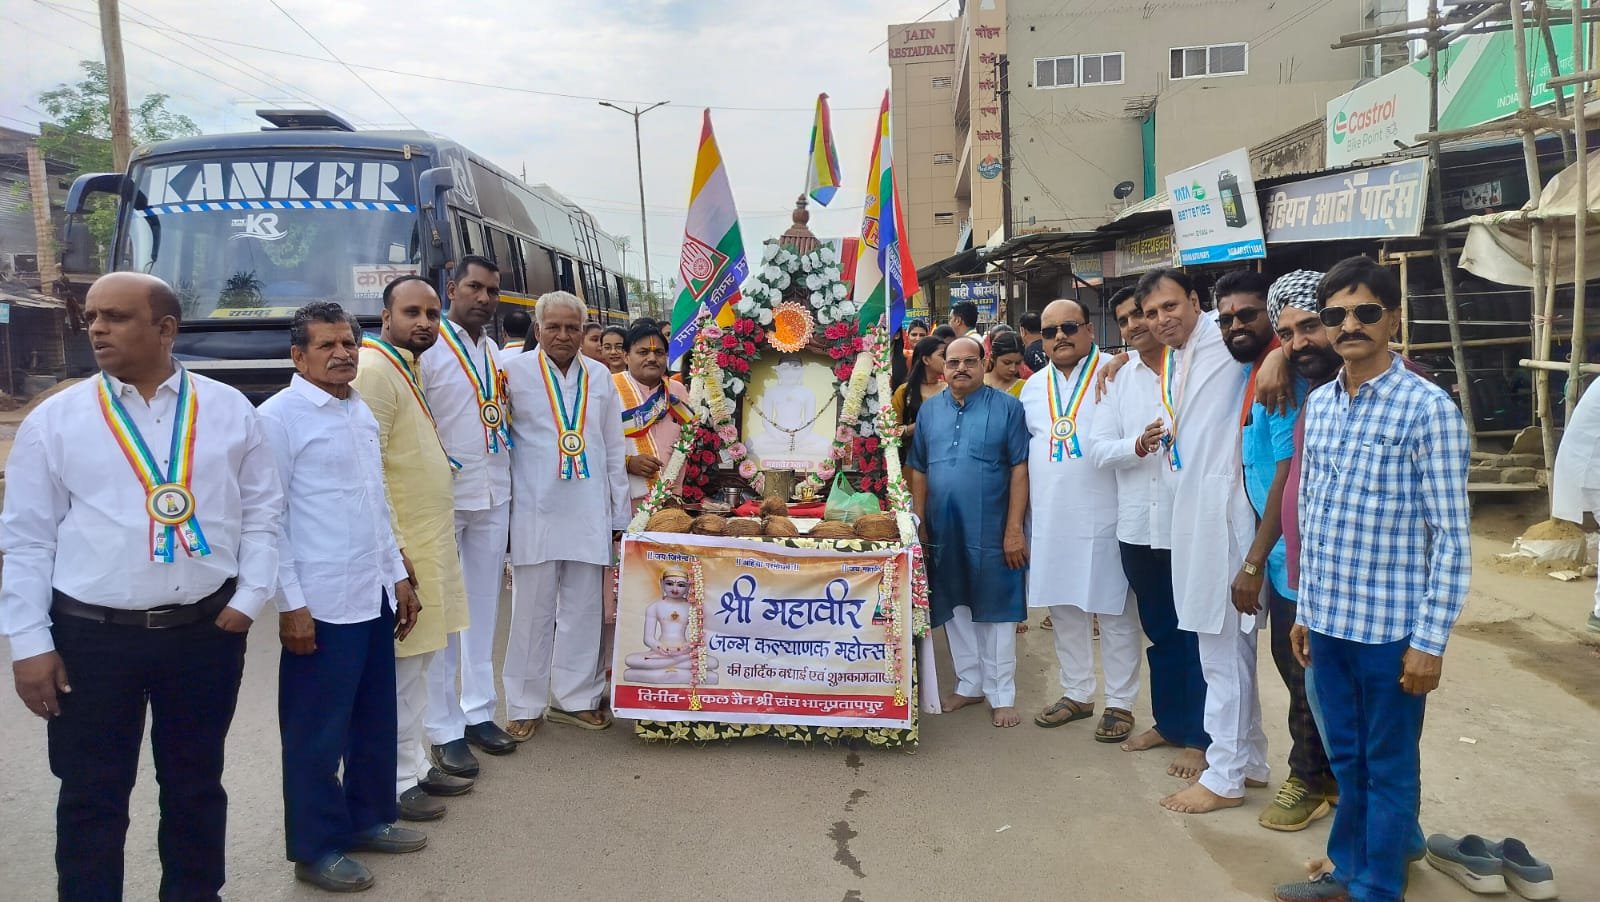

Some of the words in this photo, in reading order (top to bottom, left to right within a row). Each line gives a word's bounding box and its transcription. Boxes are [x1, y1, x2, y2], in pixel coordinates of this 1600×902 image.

[904, 28, 937, 44] JAIN
[888, 44, 956, 59] RESTAURANT
[1496, 93, 1520, 110] INDIA
[1348, 94, 1397, 134] Castrol
[1346, 137, 1361, 153] Bike
[1362, 130, 1383, 148] Point
[149, 160, 401, 206] KANKER
[1173, 184, 1191, 202] TATA
[1360, 169, 1419, 231] पार्ट्स
[355, 264, 418, 288] कांके
[714, 574, 757, 626] श्री
[761, 577, 867, 630] महावीर
[709, 632, 751, 654] जन्म
[754, 636, 831, 658] कल्याणक
[834, 635, 897, 662] महोत्स
[727, 662, 742, 678] की
[743, 662, 777, 679] हार्दिक
[808, 667, 828, 682] एवं
[687, 693, 729, 706] कल
[731, 691, 753, 706] जैन
[755, 691, 775, 706] श्री
[775, 695, 801, 708] संघ
[801, 698, 885, 713] भानुप्रतापपुर
